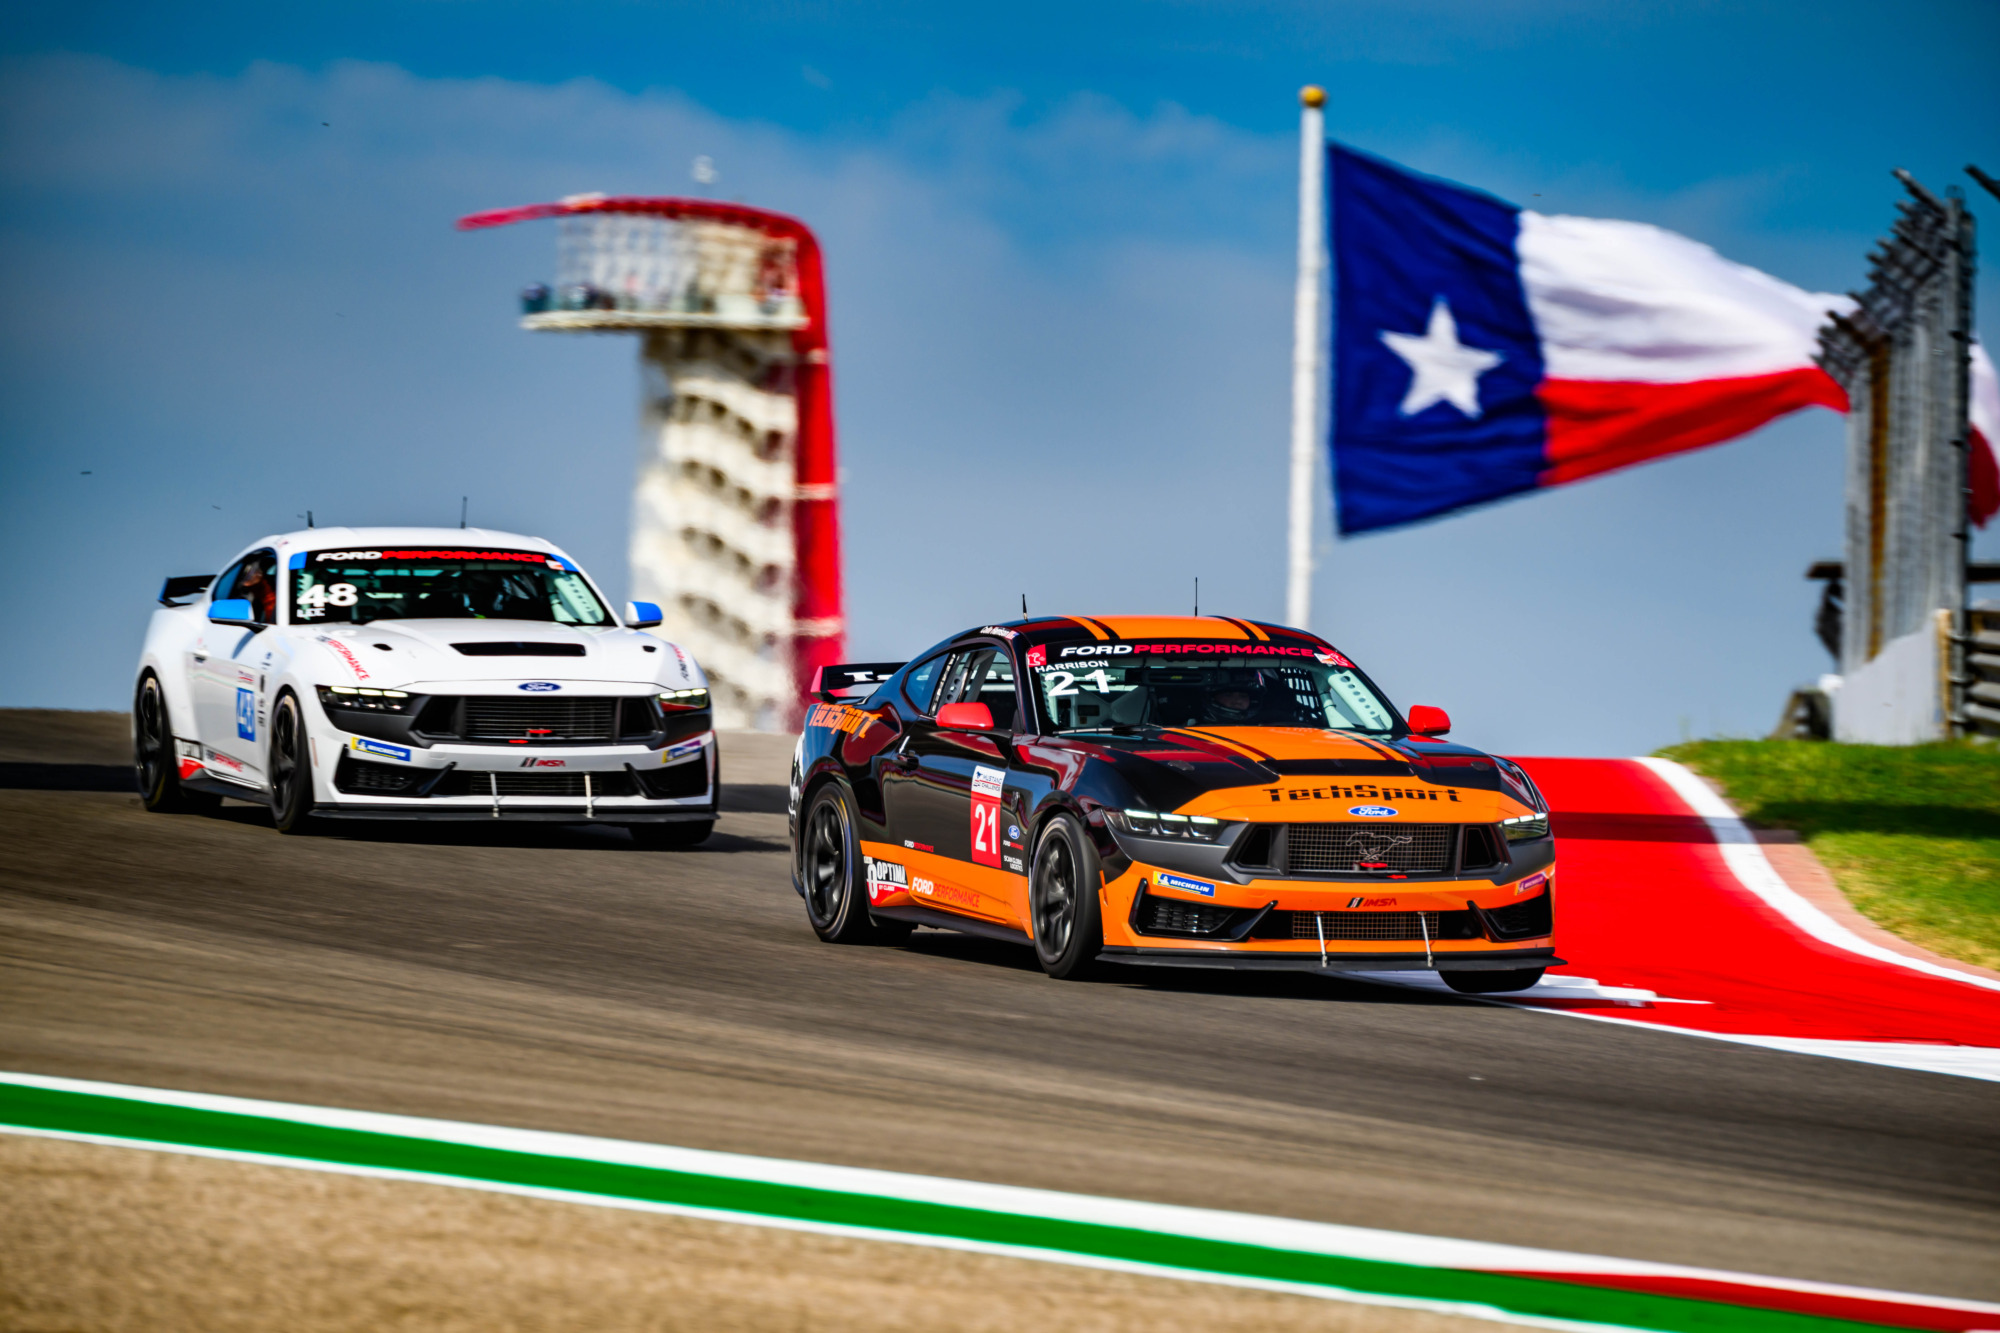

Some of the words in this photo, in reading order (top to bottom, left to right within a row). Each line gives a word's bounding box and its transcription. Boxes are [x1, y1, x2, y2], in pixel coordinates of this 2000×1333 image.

[316, 551, 382, 561] FORD
[381, 550, 545, 563] PERFORMANCE
[297, 583, 358, 608] 48
[1060, 645, 1132, 657] FORD
[1133, 644, 1315, 657] PERFORMANCE
[1034, 660, 1109, 673] HARRISON
[1044, 669, 1110, 697] 21
[535, 759, 566, 767] IMSA
[1262, 784, 1463, 803] TechSport
[1358, 806, 1389, 816] Ford
[974, 803, 997, 855] 21
[876, 861, 906, 884] OPTIMA
[912, 877, 934, 895] FORD
[933, 883, 980, 908] PERFORMANCE
[1170, 879, 1210, 893] MICHELIN
[1363, 898, 1397, 907] IMSA
